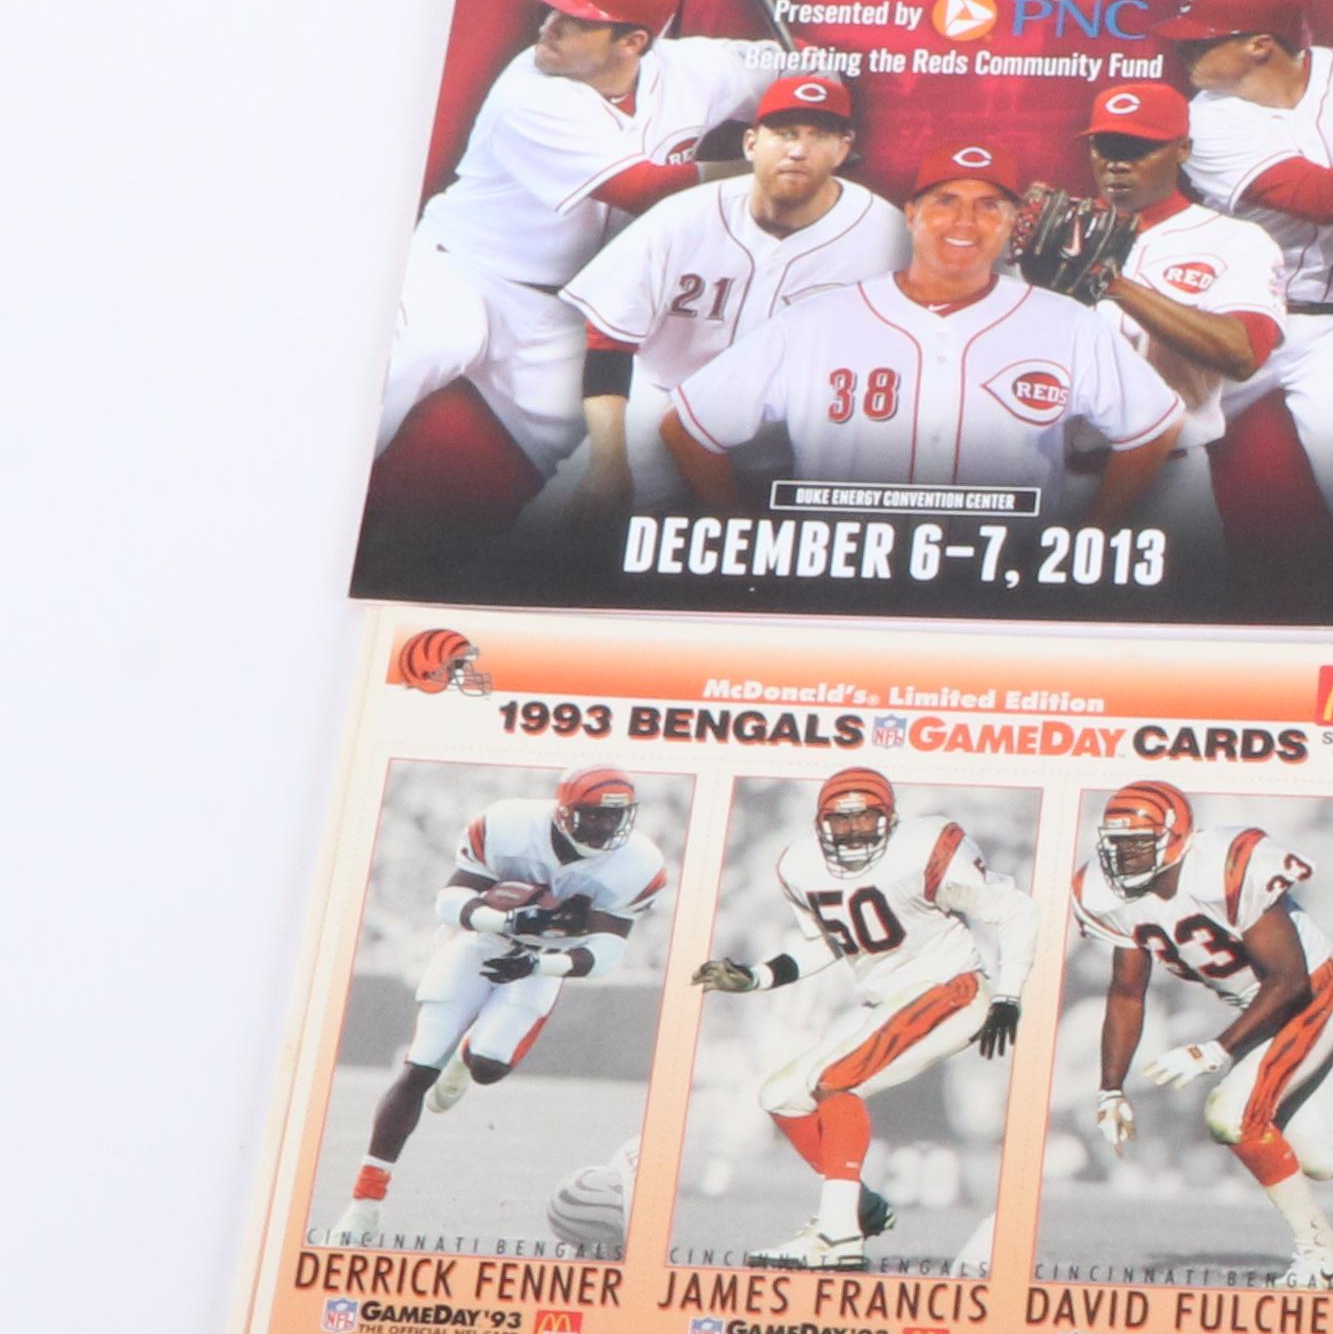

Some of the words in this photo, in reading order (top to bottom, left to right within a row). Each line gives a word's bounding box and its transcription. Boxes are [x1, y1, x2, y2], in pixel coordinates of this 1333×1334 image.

[895, 0, 922, 30] by
[745, 46, 863, 77] Benefiting
[868, 49, 907, 73] the
[912, 50, 968, 75] Reds
[975, 50, 1102, 82] Community
[1108, 52, 1164, 78] Fund
[667, 273, 735, 321] 21
[828, 367, 900, 424] 38
[1015, 378, 1070, 407] REDS
[795, 487, 831, 505] DUKE
[832, 488, 881, 507] ENERGY
[882, 489, 965, 509] CONVENTION
[966, 491, 1016, 511] CENTER
[622, 515, 895, 580] DECEMBER
[1037, 526, 1167, 585] 2013
[888, 685, 996, 710] Limited
[1004, 689, 1105, 713] Edition
[499, 699, 613, 739] 1993
[627, 706, 866, 750] BENGALS
[1132, 724, 1310, 764] CARDS
[806, 885, 908, 956] 50
[294, 1250, 458, 1298] DERRICK
[474, 1260, 624, 1308] FENNER
[657, 1270, 792, 1316] JAMES
[813, 1277, 990, 1324] FRANCIS
[1025, 1286, 1150, 1329] DAVID
